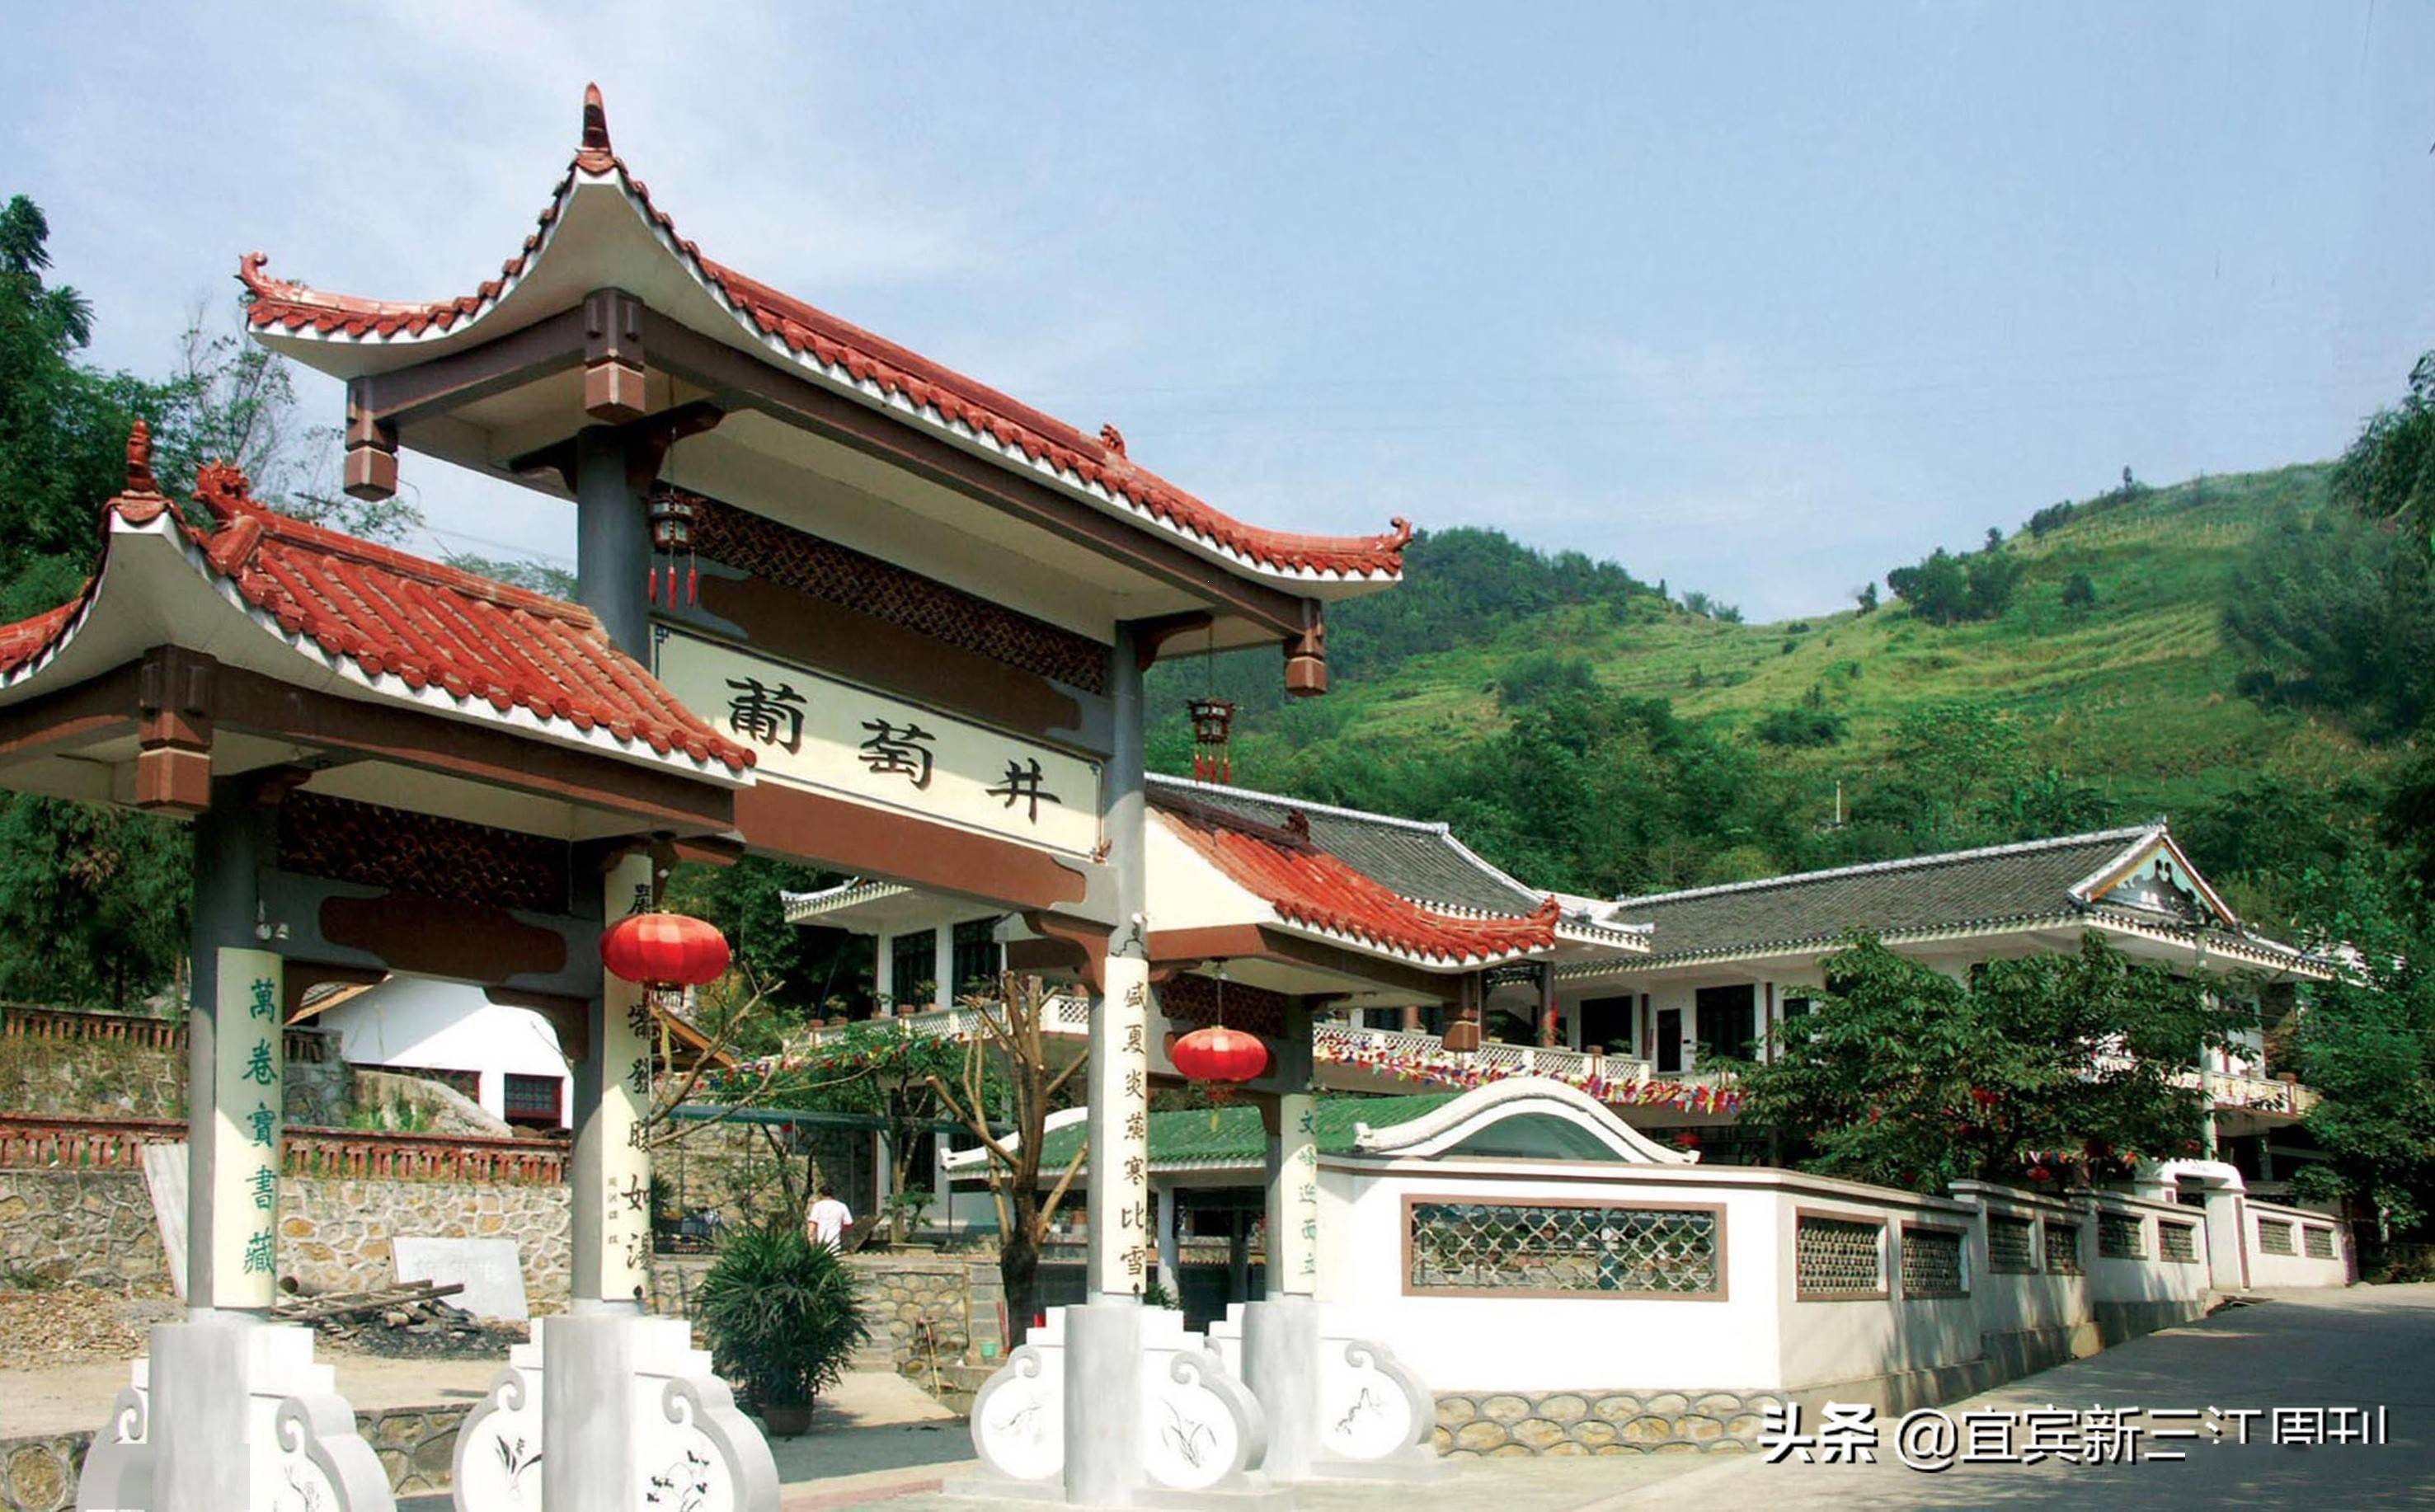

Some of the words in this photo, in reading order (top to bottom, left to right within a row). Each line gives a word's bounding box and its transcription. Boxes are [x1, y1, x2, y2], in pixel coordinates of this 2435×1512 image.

[726, 677, 1061, 824] 葡萄井
[242, 978, 277, 1276] 萬卷寶書藏
